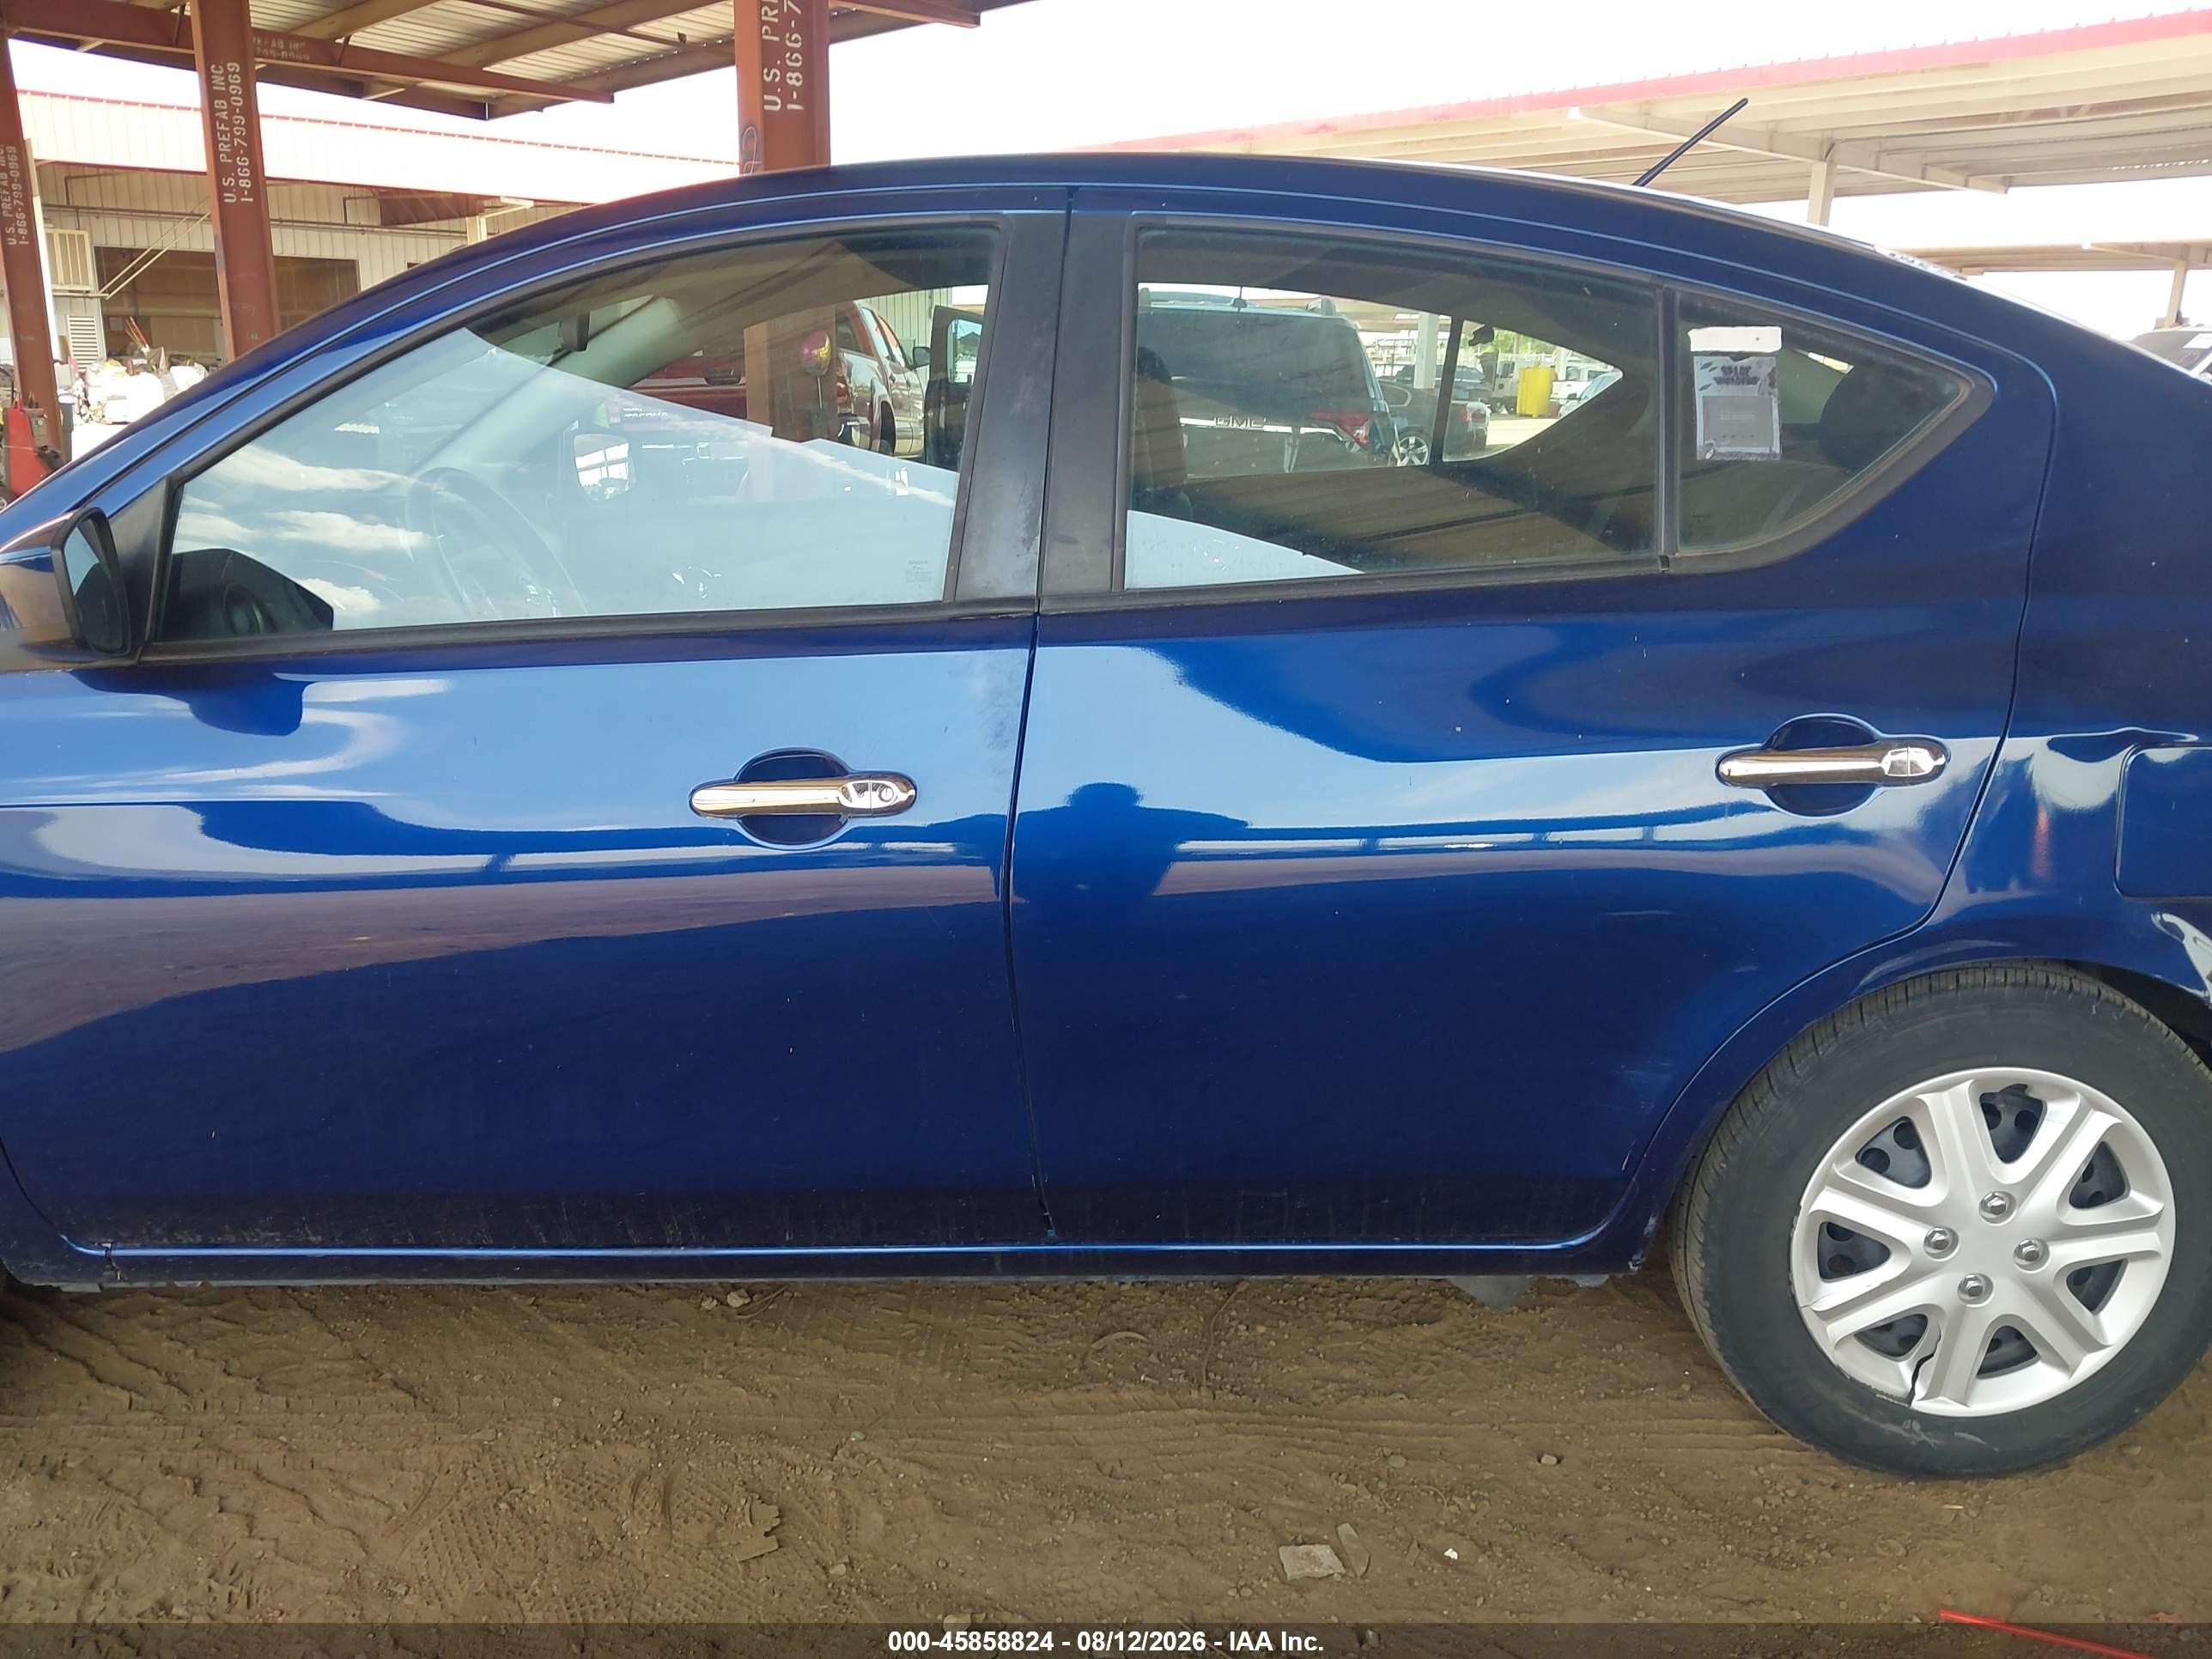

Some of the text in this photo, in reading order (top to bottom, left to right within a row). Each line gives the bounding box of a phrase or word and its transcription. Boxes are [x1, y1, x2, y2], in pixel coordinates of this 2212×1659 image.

[762, 0, 781, 112] U.S. PR
[214, 99, 233, 162] PREFAB
[227, 62, 254, 203] 1-866-799-0969
[6, 146, 29, 245] 1-866-799-0969
[222, 172, 238, 204] U.S.
[5, 223, 17, 246] U.S.
